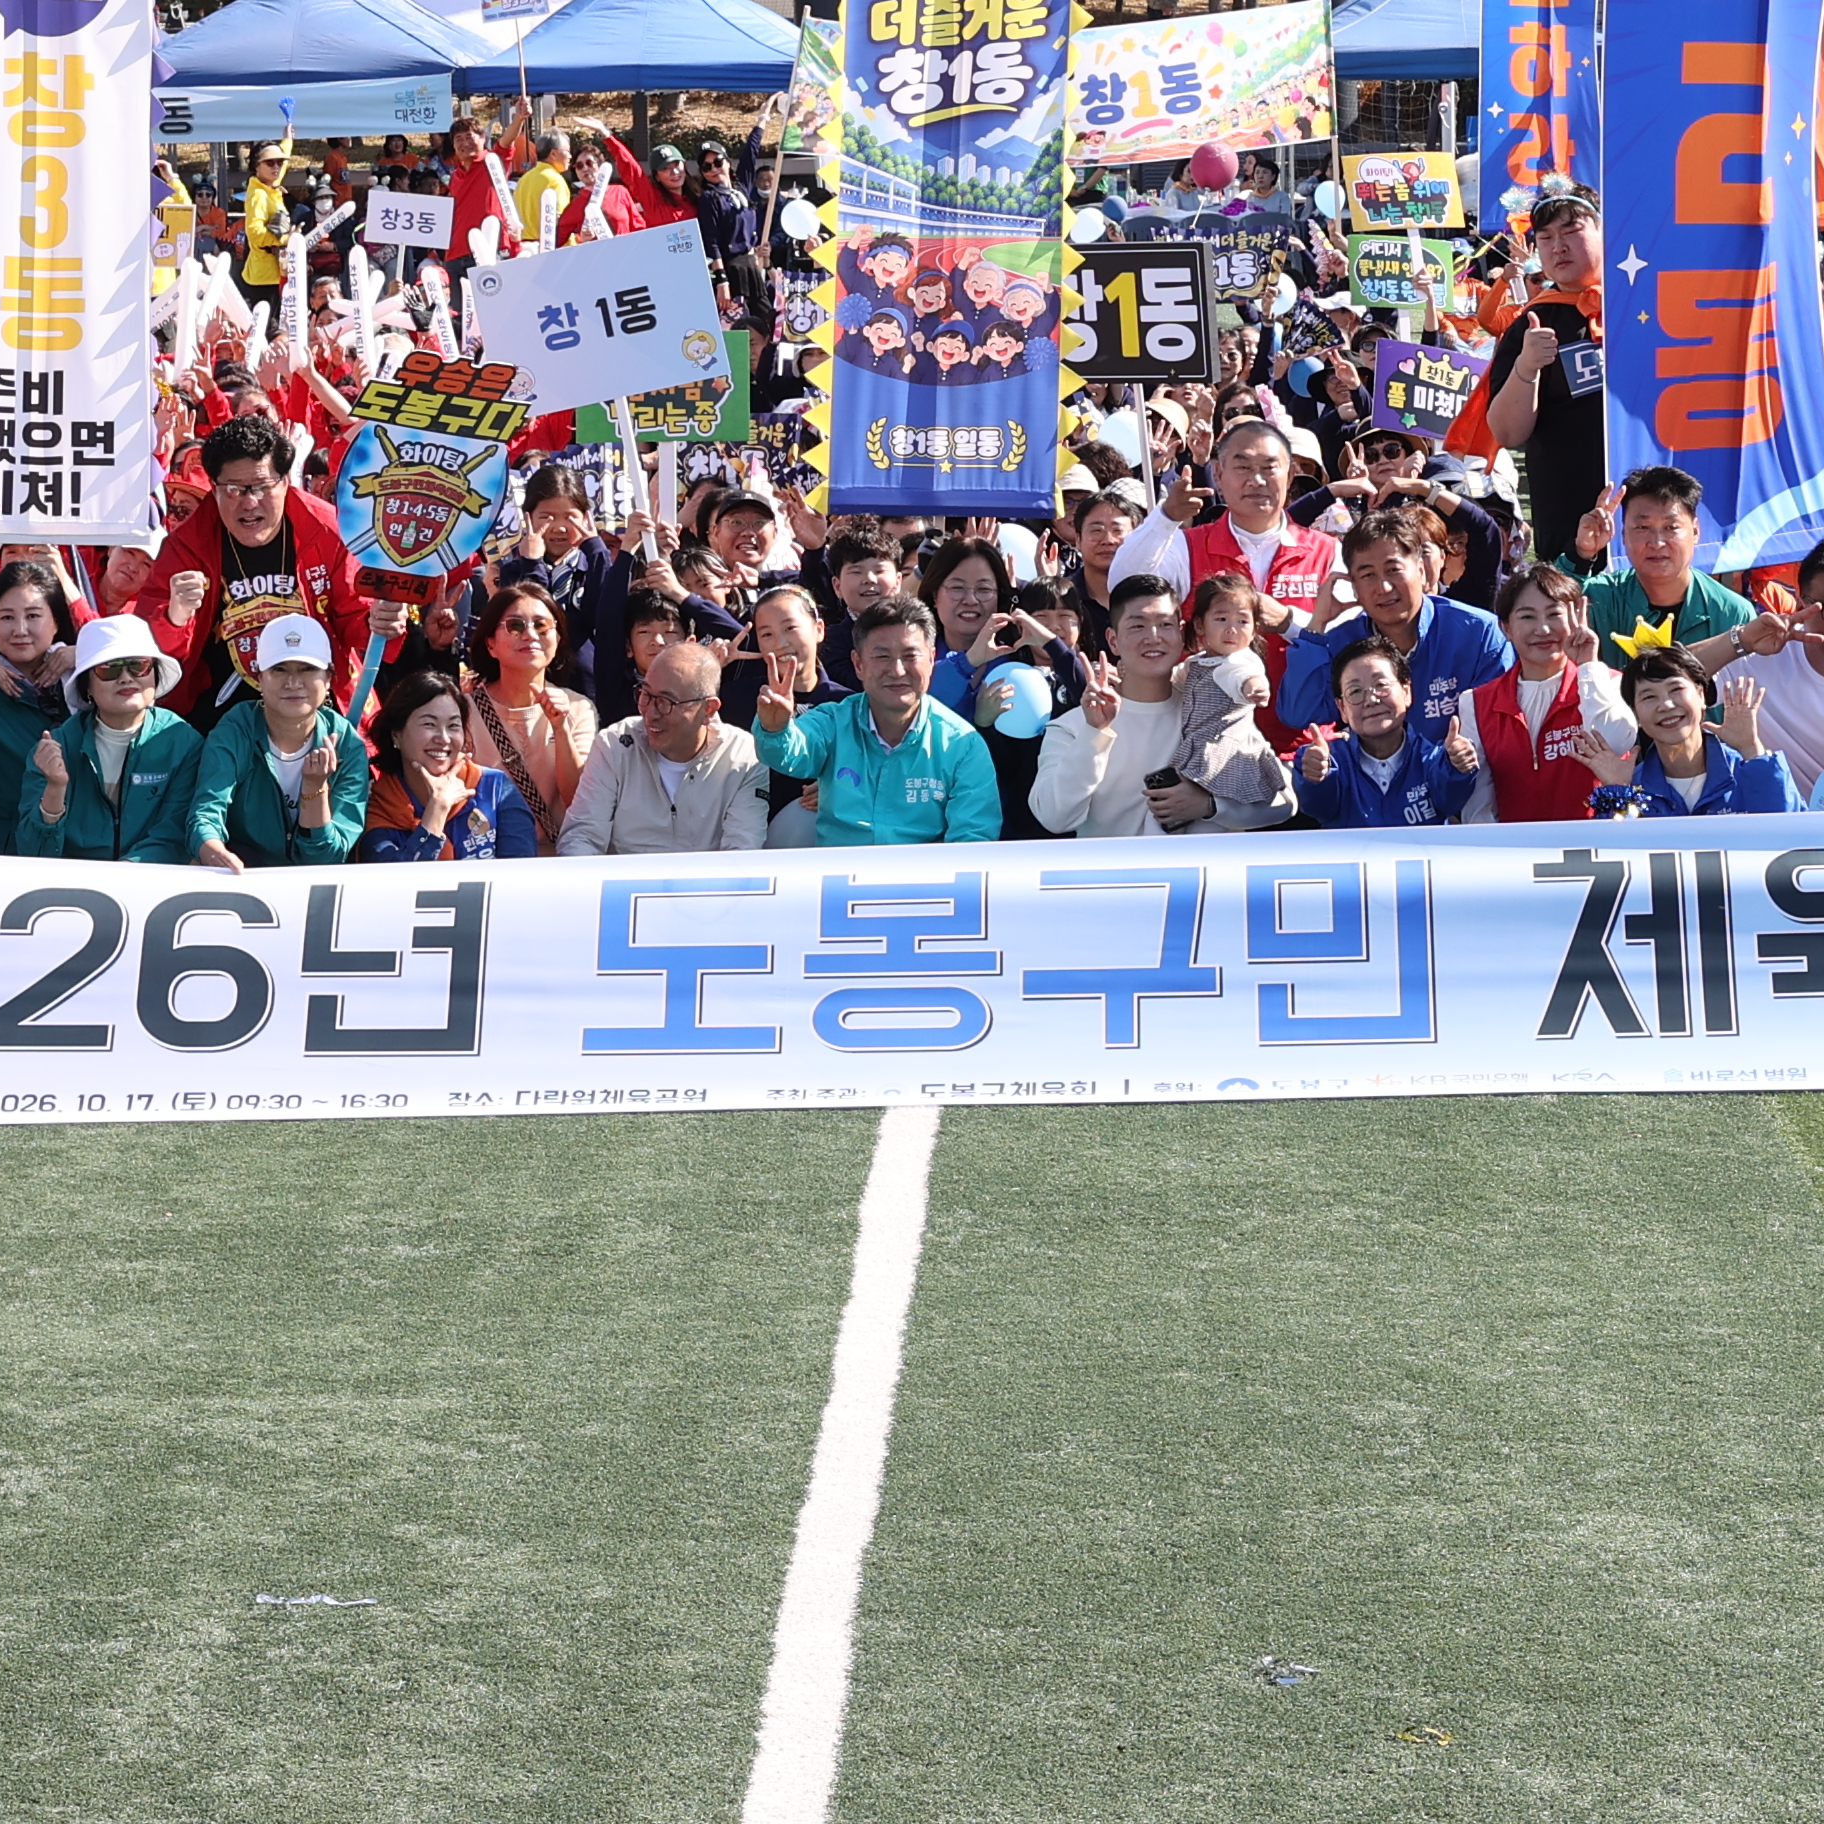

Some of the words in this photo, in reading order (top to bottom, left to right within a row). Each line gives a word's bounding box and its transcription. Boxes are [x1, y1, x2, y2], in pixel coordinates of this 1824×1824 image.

[878, 41, 1034, 114] 창1동
[394, 90, 416, 107] 도봉
[1080, 62, 1202, 125] 창1동
[395, 107, 438, 125] 대전환
[3, 51, 96, 352] 창3동
[1355, 180, 1392, 201] 뛰는
[1413, 180, 1449, 198] 위에
[380, 208, 437, 234] 창3동
[1369, 203, 1403, 225] 나는
[1405, 201, 1446, 224] 창1동
[1360, 241, 1402, 258] 어디서
[1364, 279, 1400, 301] 창1동
[537, 302, 581, 352] 창
[594, 285, 658, 339] 1동
[395, 352, 517, 400] 우승은
[1426, 364, 1457, 386] 창1동
[1387, 380, 1407, 408] 폼
[350, 380, 529, 441] 도봉구다
[890, 425, 949, 459] 창1동
[953, 426, 1004, 460] 일동
[399, 443, 466, 471] 화이팅
[229, 574, 296, 601] 화이팅
[1271, 582, 1319, 599] 강신만
[904, 777, 945, 789] 도봉구청장
[578, 857, 1438, 1057] 도봉구민
[76, 1093, 112, 1113] 10.
[125, 1093, 159, 1113] 17.
[170, 1091, 217, 1112] (토)
[226, 1093, 303, 1111] 09:30
[338, 1092, 409, 1110] 16:30
